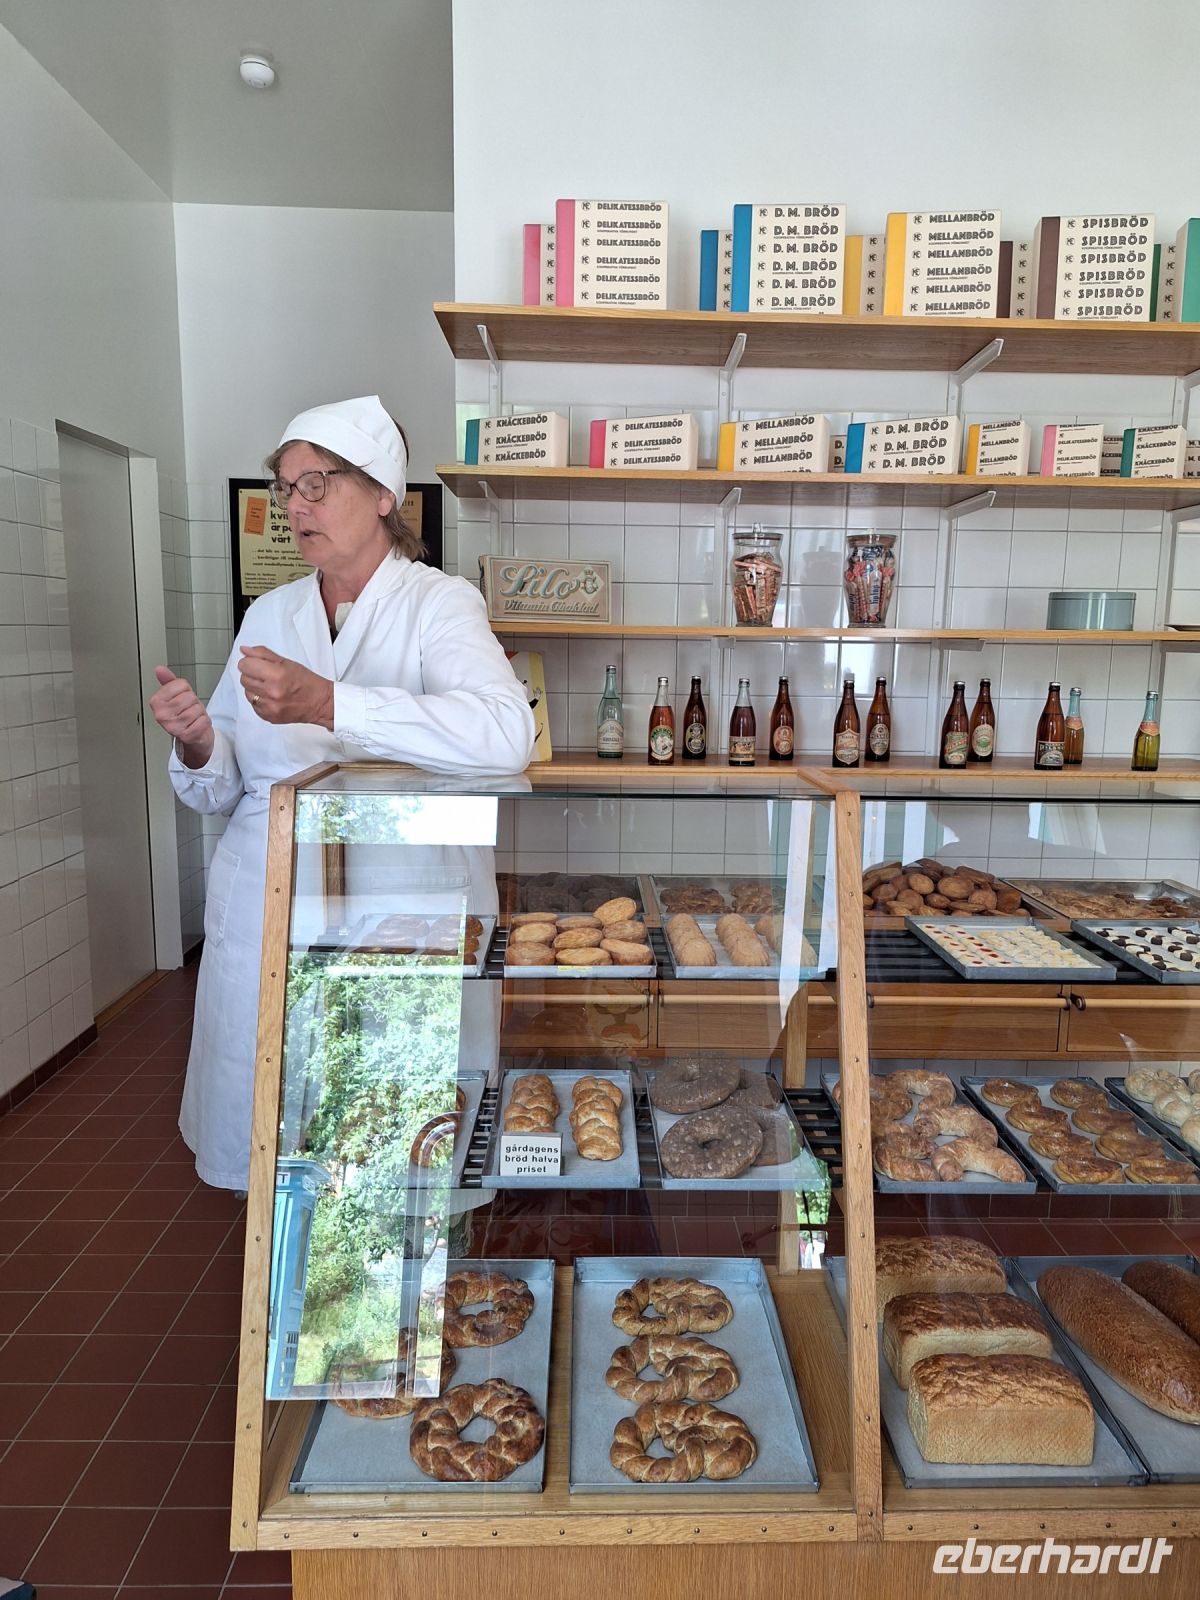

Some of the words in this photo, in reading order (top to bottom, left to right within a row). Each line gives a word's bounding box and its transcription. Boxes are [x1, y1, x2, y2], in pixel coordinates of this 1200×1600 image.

[597, 202, 662, 211] DELIKATESSBRÖD
[774, 208, 785, 218] D.
[788, 208, 800, 218] M.
[804, 204, 840, 218] BRÖD
[929, 211, 995, 223] MELLANBRÖD
[1082, 215, 1149, 229] SPISBRÖD
[597, 220, 661, 229] DELIKATESSBRÖD
[774, 226, 784, 235] D.
[787, 226, 800, 235] M.
[804, 222, 839, 235] BRÖD
[928, 228, 994, 241] MELLANBRÖD
[1081, 233, 1148, 246] SPISBRÖD
[596, 238, 661, 247] DELIKATESSBRÖD
[774, 244, 783, 253] D.
[786, 244, 799, 253] M.
[803, 240, 838, 253] BRÖD
[928, 246, 993, 259] MELLANBRÖD
[1080, 250, 1147, 263] SPISBRÖD
[596, 256, 661, 265] DELIKATESSBRÖD
[772, 261, 783, 271] D.
[786, 261, 798, 271] M.
[802, 258, 837, 271] BRÖD
[927, 264, 992, 276] MELLANBRÖD
[1079, 268, 1145, 281] SPISBRÖD
[596, 274, 660, 283] DELIKATESSBRÖD
[772, 279, 782, 289] D.
[785, 279, 798, 289] M.
[802, 276, 836, 289] BRÖD
[926, 281, 991, 294] MELLANBRÖD
[1078, 285, 1144, 298] SPISBRÖD
[595, 292, 660, 301] DELIKATESSBRÖD
[772, 297, 782, 307] D.
[784, 297, 797, 307] M.
[801, 294, 836, 306] BRÖD
[925, 299, 990, 311] MELLANBRÖD
[1077, 303, 1143, 316] SPISBRÖD
[496, 414, 548, 428] KNÄCKEBRÖD
[625, 418, 683, 431] DELIKATESSBRÖD
[755, 414, 815, 430] MELLANBRÖD
[886, 425, 895, 434] D.
[898, 424, 910, 434] M.
[914, 418, 949, 432] BRÖD
[496, 431, 547, 445] KNÄCKEBRÖD
[624, 436, 682, 448] DELIKATESSBRÖD
[754, 432, 814, 447] MELLANBRÖD
[884, 442, 894, 452] D.
[897, 441, 909, 450] M.
[913, 436, 947, 449] BRÖD
[981, 438, 1020, 447] MELLANBRÖD
[495, 449, 546, 462] KNÄCKEBRÖD
[623, 453, 681, 465] DELIKATESSBRÖD
[753, 450, 812, 464] MELLANBRÖD
[883, 459, 892, 469] D.
[895, 458, 907, 468] M.
[911, 454, 946, 466] BRÖD
[979, 455, 1018, 464] MELLANBRÖD
[271, 522, 280, 531] är
[272, 534, 291, 543] värt
[506, 1144, 559, 1153] gårdagens
[532, 1155, 559, 1163] halva
[516, 1166, 547, 1174] priset
